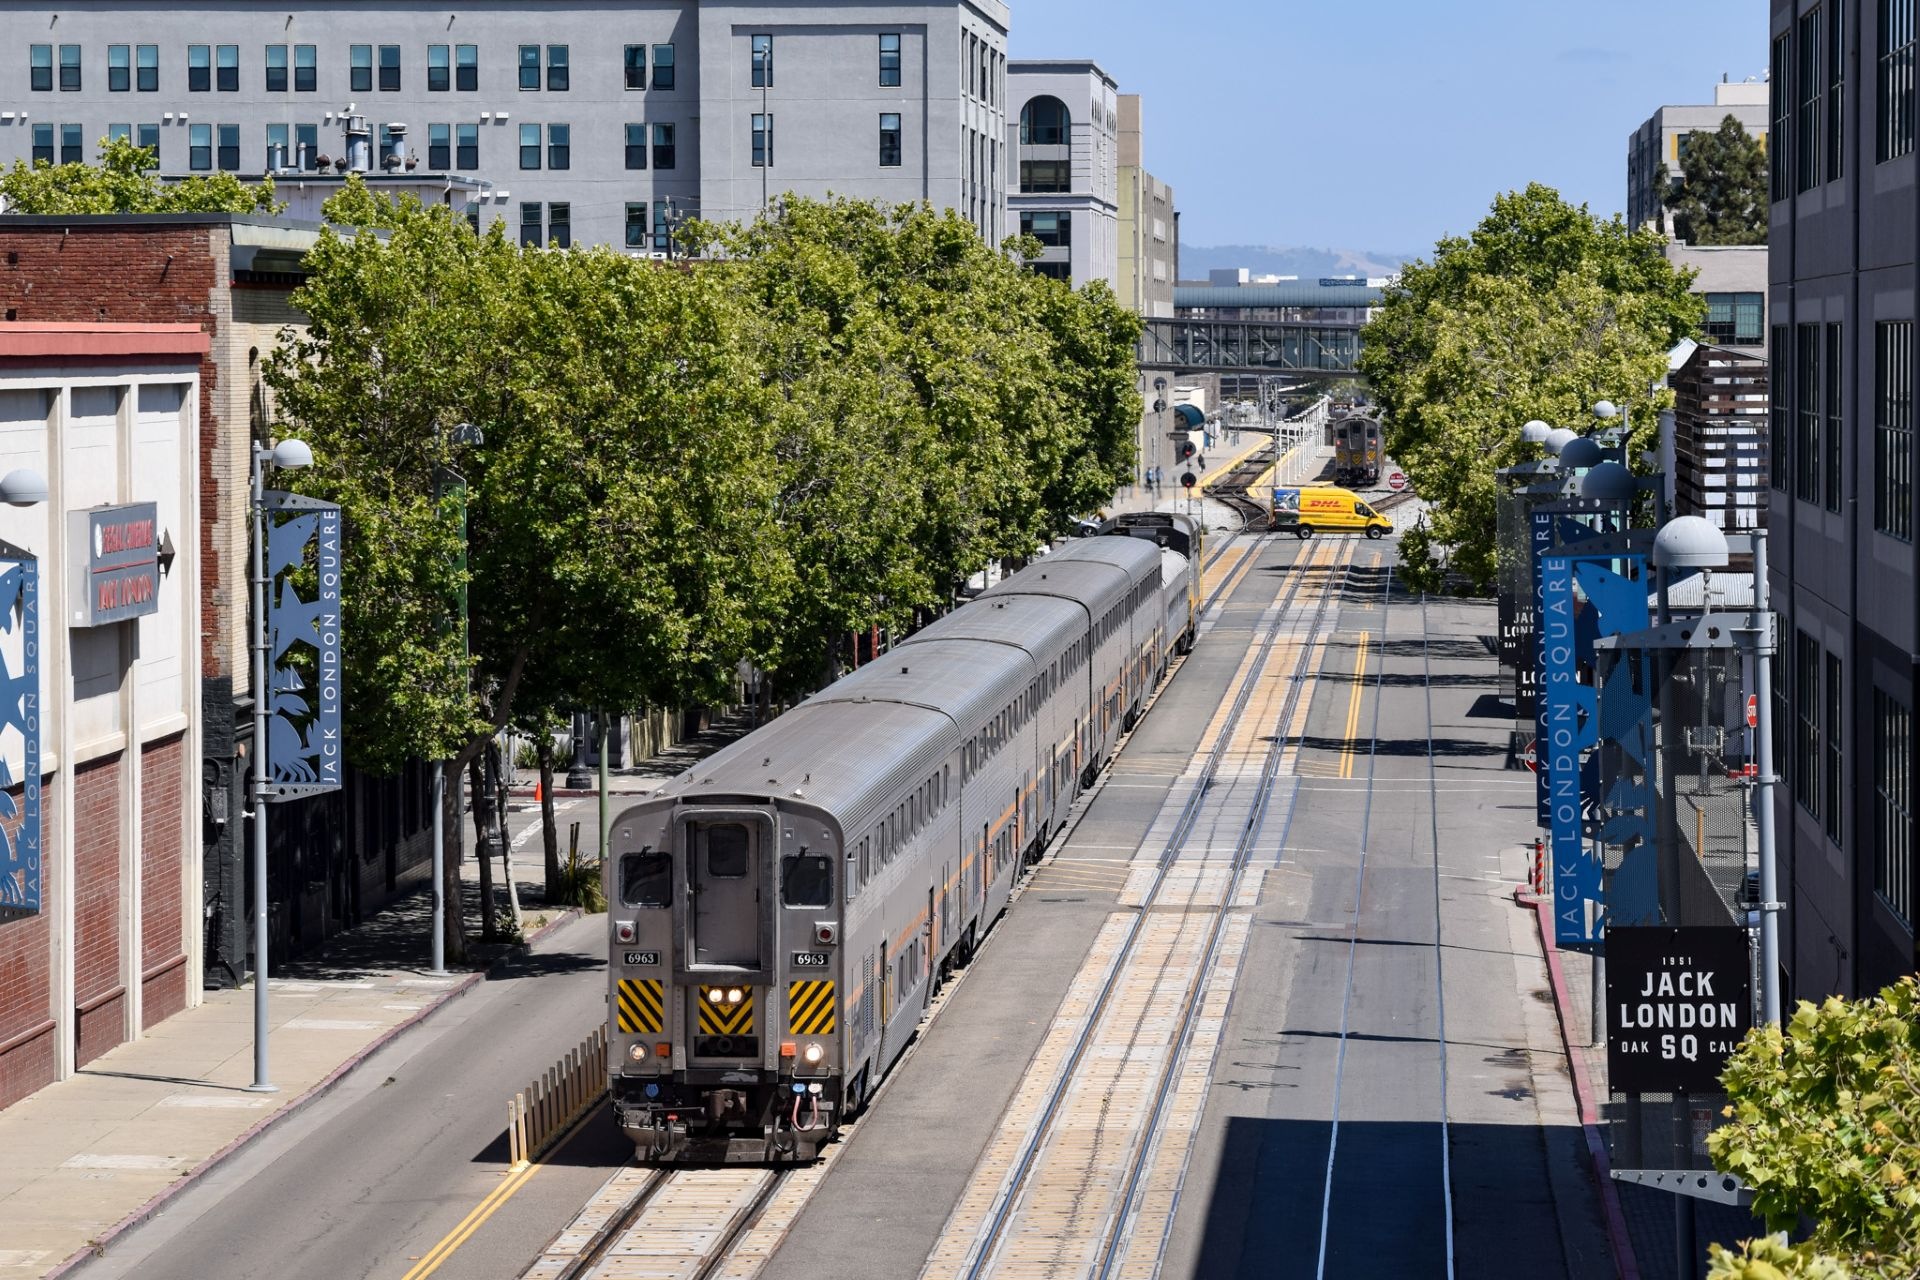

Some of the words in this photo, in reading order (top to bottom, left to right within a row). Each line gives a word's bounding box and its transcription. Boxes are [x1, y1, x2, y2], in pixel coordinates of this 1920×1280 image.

[324, 511, 338, 599] SQUARE
[26, 563, 38, 674] SQUARE
[1548, 559, 1571, 683] SQUARE
[324, 614, 337, 713] LONDON
[27, 693, 38, 817] LONDON
[324, 728, 337, 783] JACK
[1553, 704, 1576, 841] LONDON
[27, 837, 38, 906] JACK
[1559, 862, 1580, 939] JACK
[628, 953, 655, 964] 6963
[797, 954, 825, 964] 6963
[1641, 972, 1715, 996] JACK
[1662, 956, 1692, 965] 1951
[1621, 1003, 1737, 1028] LONDON
[1621, 1041, 1649, 1053] OAK
[1661, 1034, 1698, 1062] SQ
[1709, 1041, 1736, 1053] CAL
